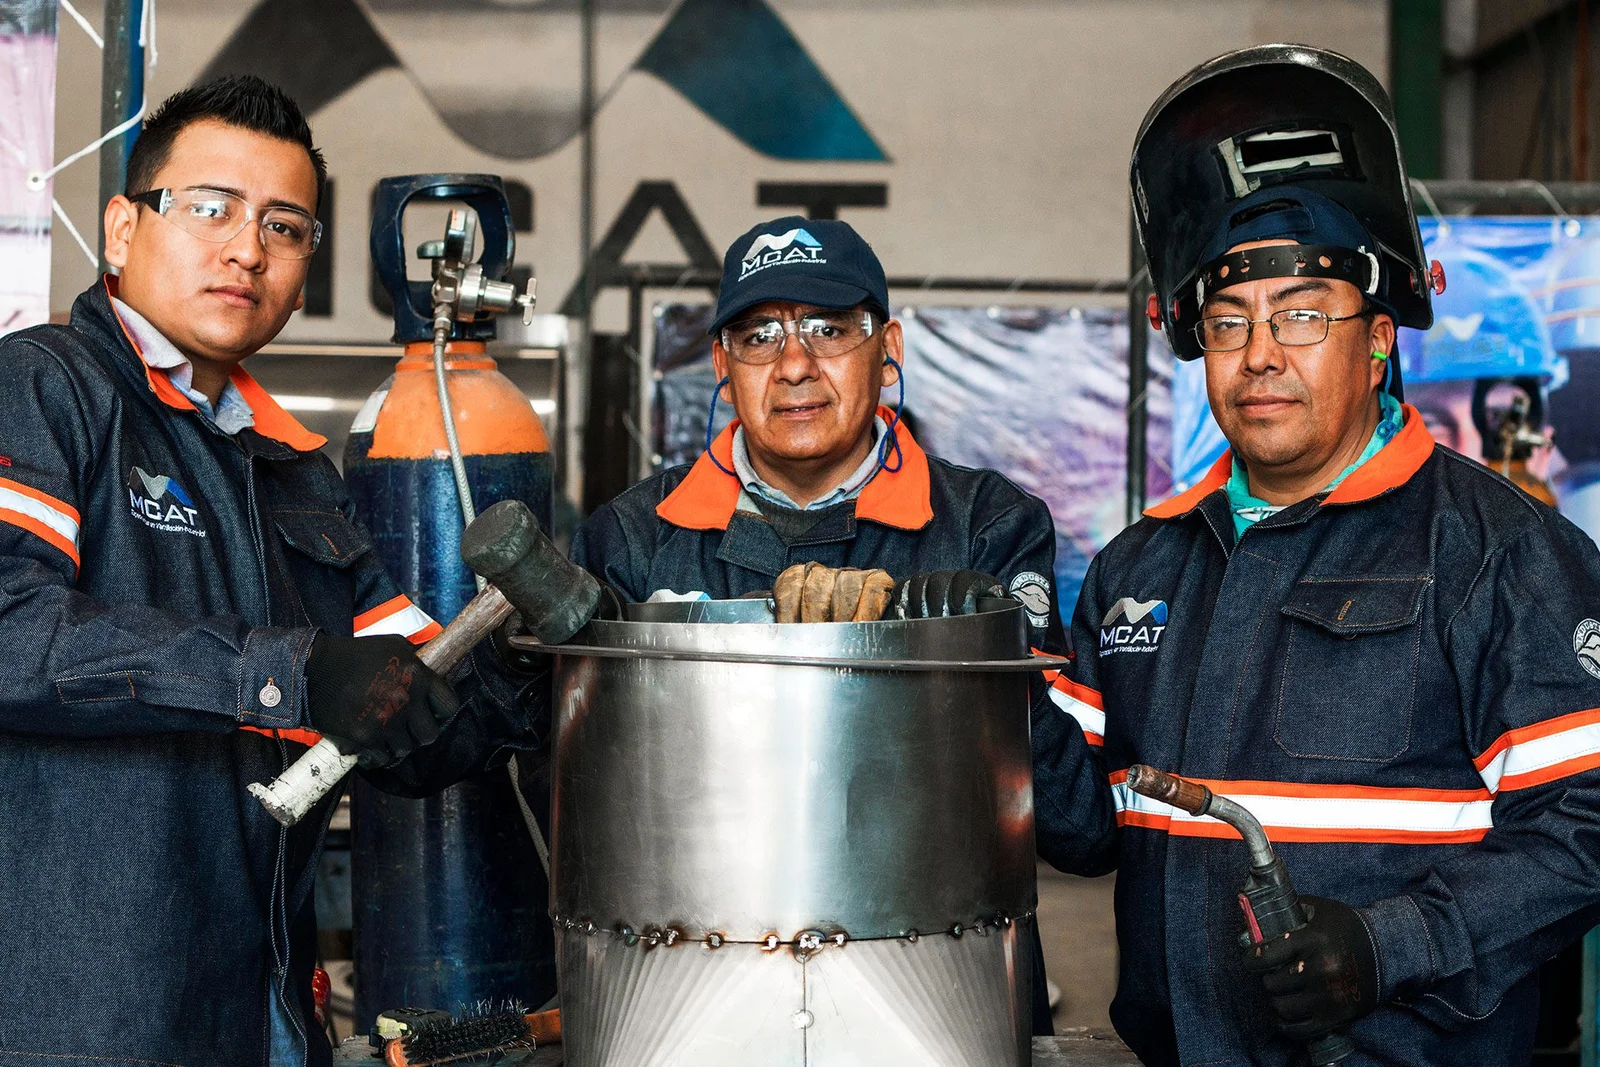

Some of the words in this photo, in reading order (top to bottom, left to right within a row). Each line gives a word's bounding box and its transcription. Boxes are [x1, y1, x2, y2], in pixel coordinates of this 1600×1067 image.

[741, 247, 822, 275] MCAT
[129, 488, 198, 526] MCAT
[1100, 626, 1166, 648] MCAT
